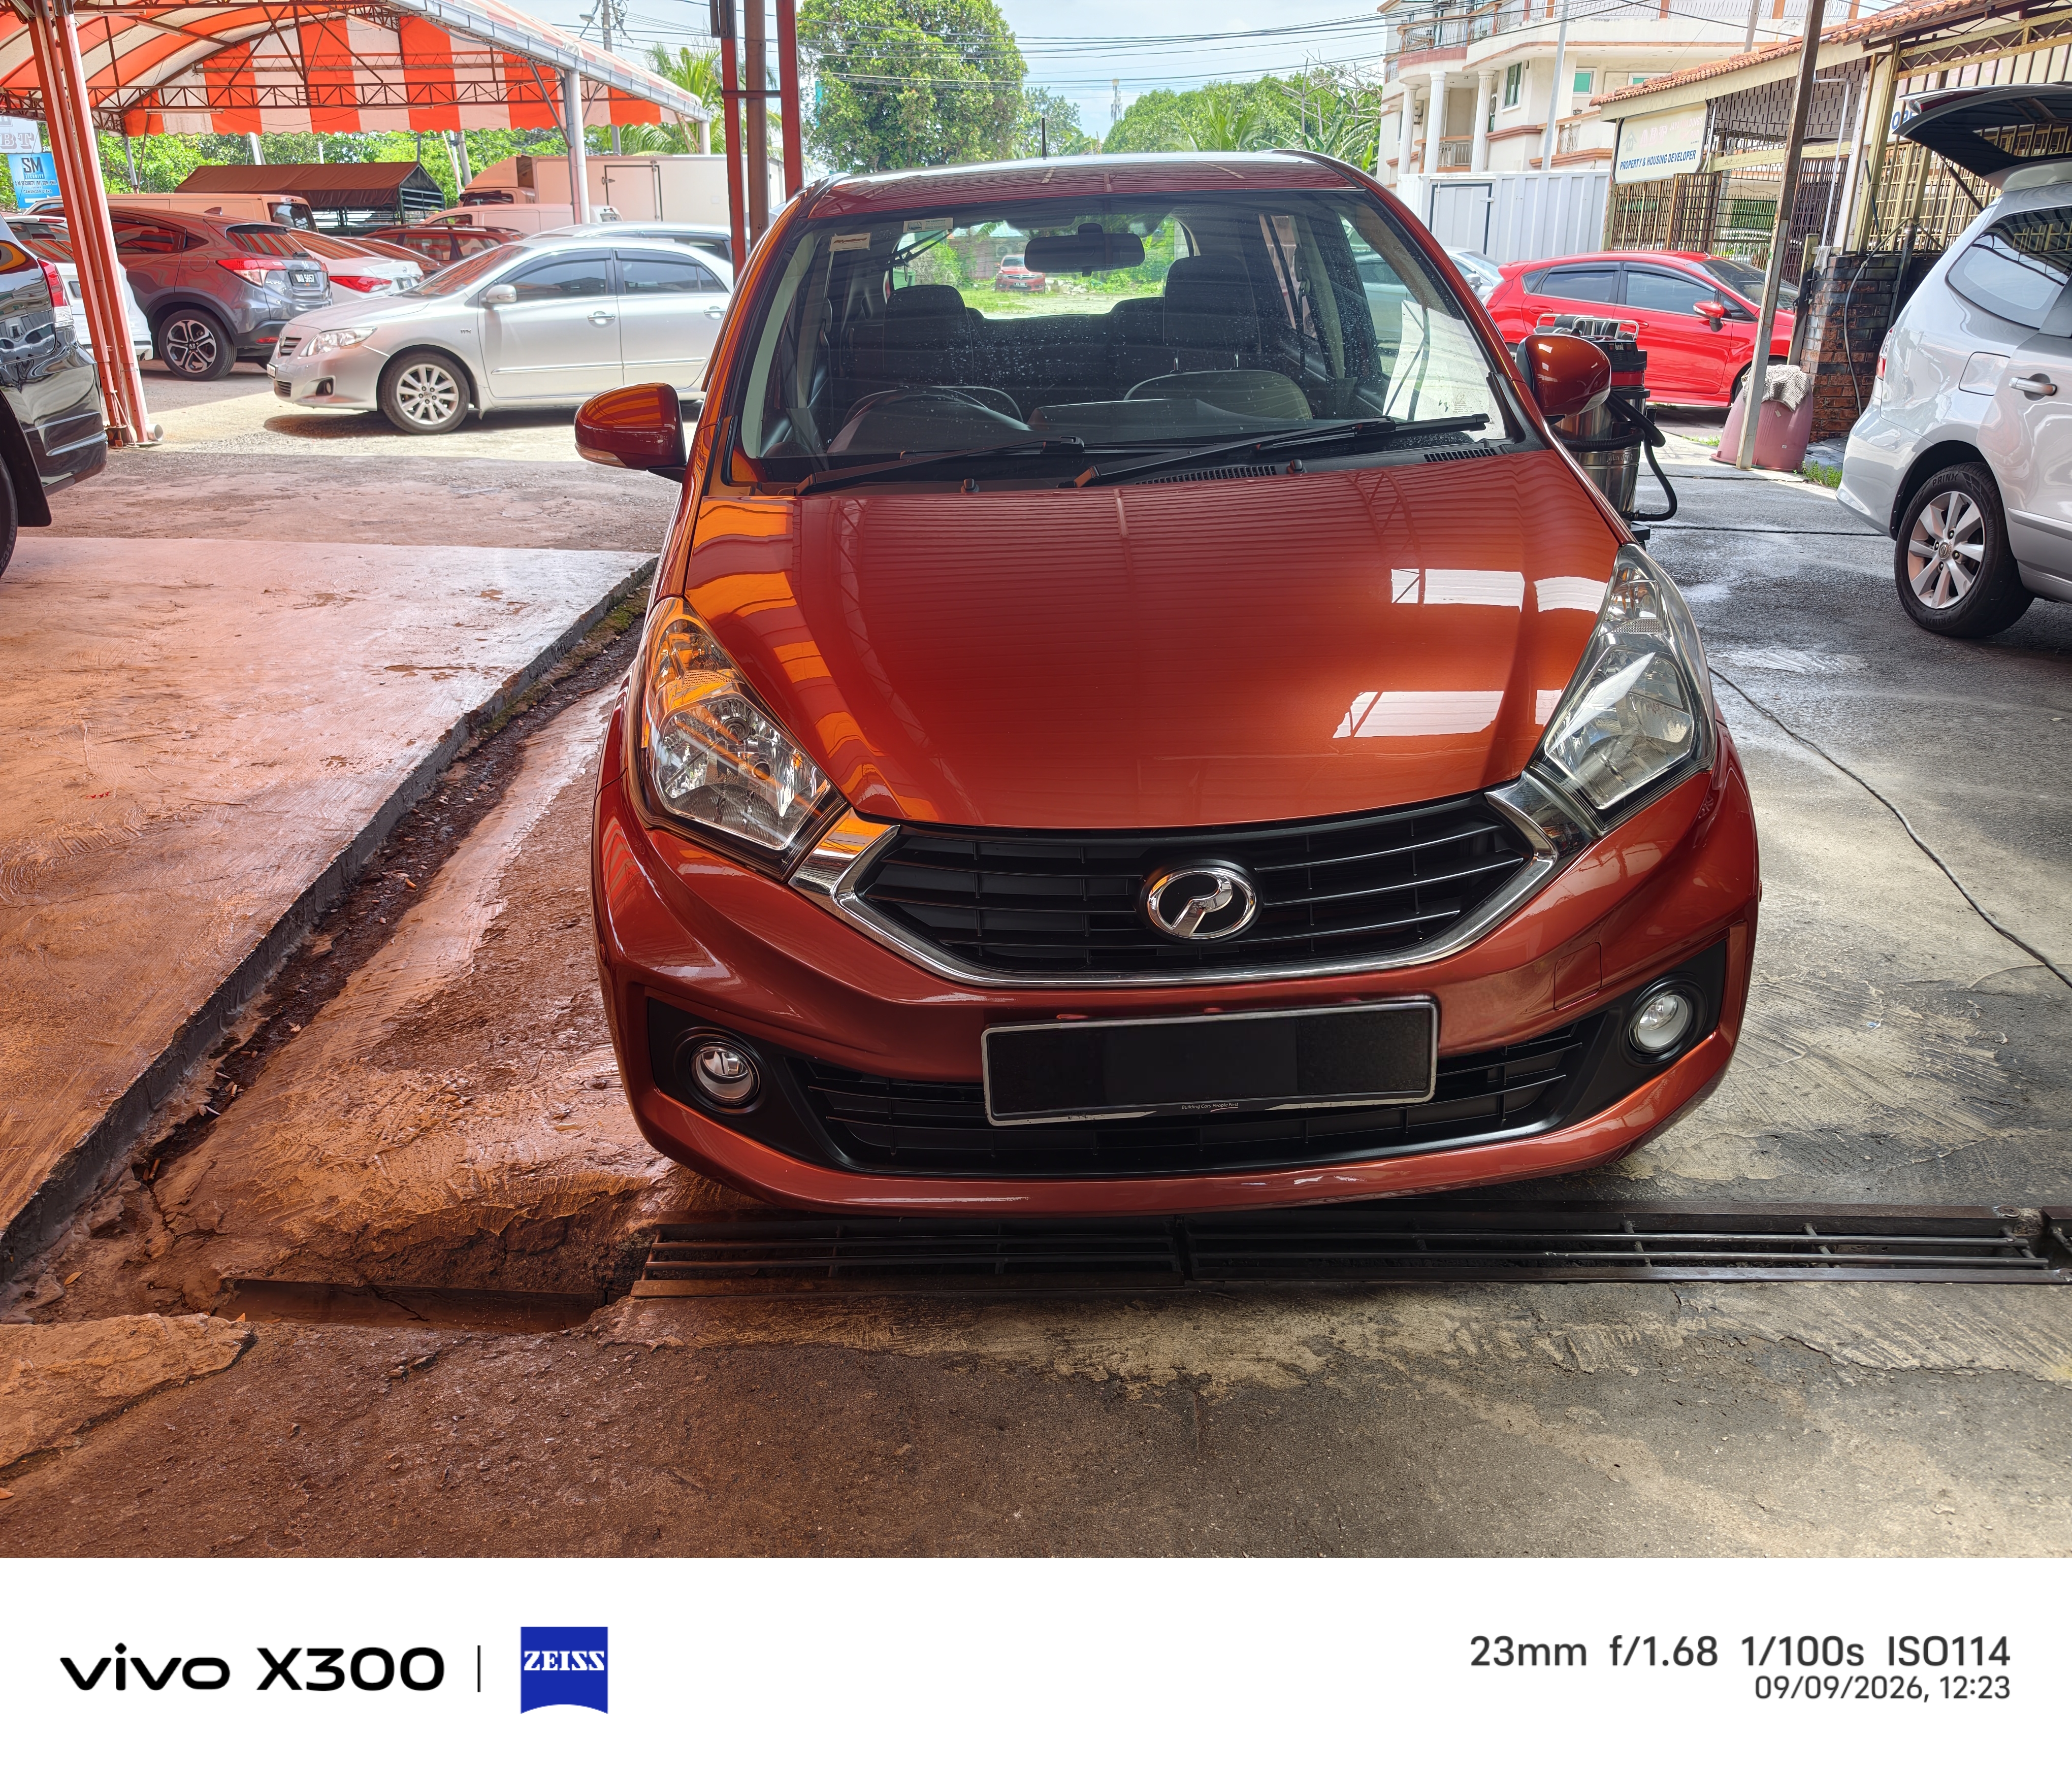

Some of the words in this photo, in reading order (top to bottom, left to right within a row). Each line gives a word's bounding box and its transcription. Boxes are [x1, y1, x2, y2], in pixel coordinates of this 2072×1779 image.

[1639, 125, 1668, 148] ABT
[21, 157, 43, 173] SM
[1620, 158, 1643, 171] PROPERTY
[1642, 157, 1645, 166] &
[1646, 154, 1667, 166] HOUSING
[1668, 150, 1696, 163] DEVELOPER
[1932, 473, 1959, 487] PRINX
